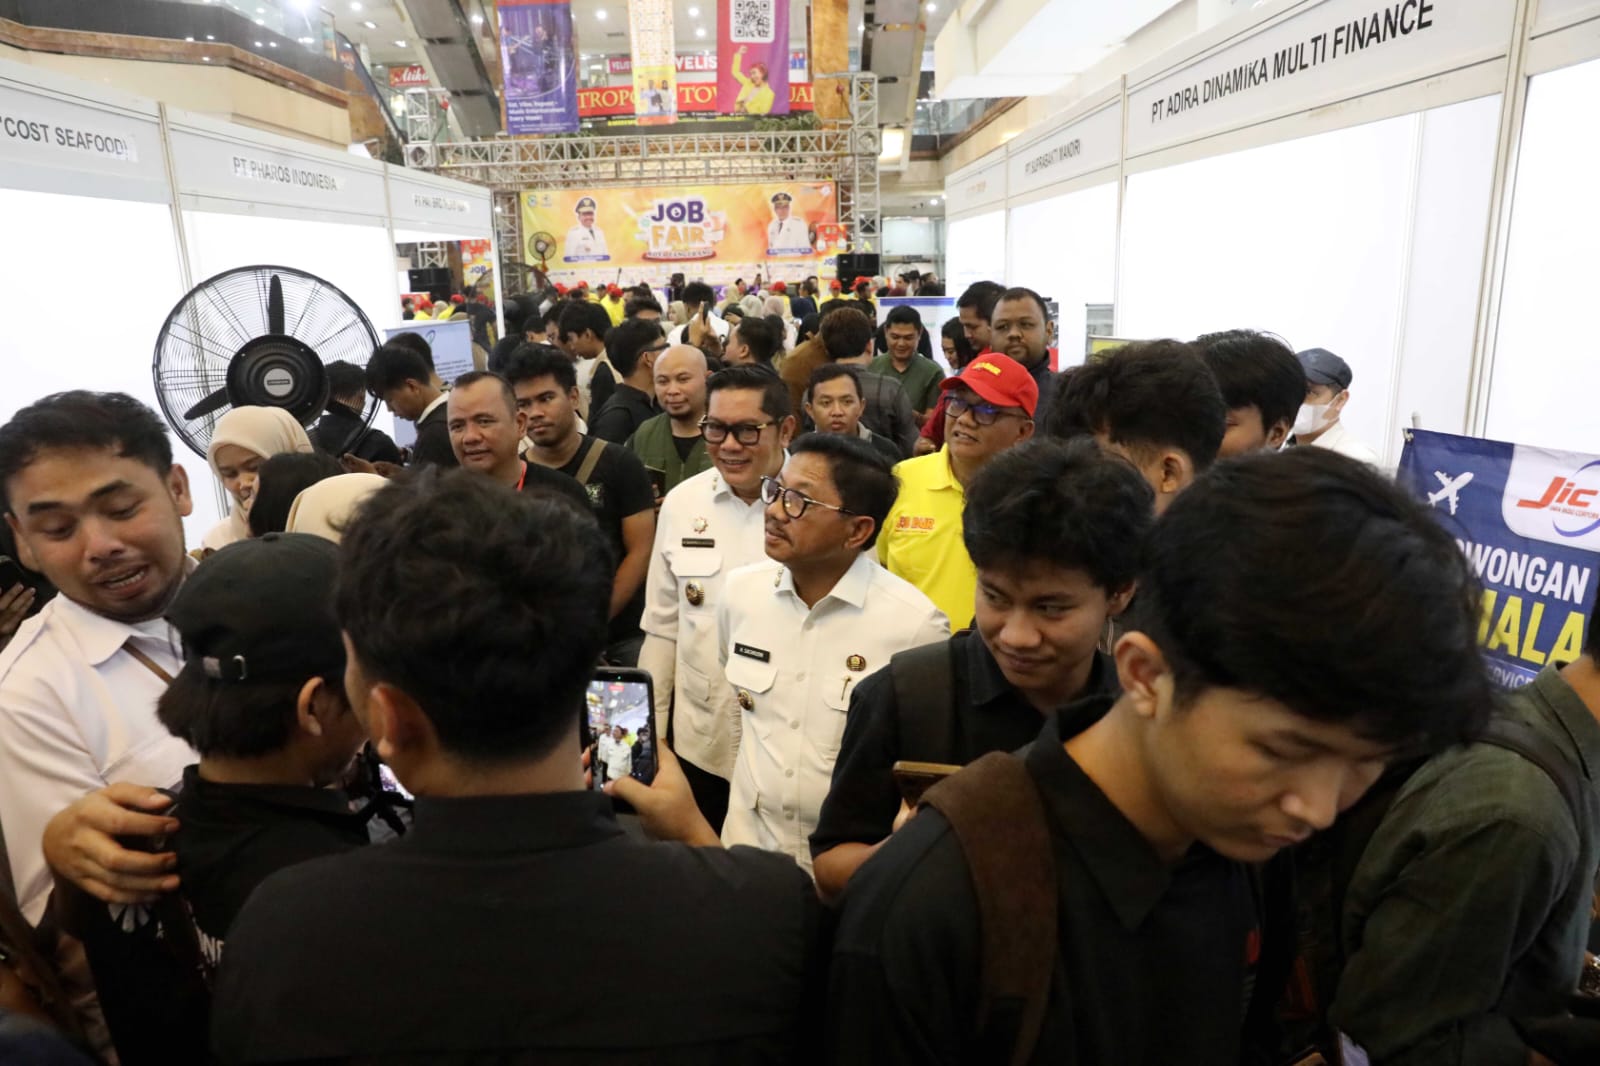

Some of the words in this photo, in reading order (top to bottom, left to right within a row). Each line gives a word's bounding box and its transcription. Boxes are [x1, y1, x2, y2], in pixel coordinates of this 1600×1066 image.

[1151, 98, 1165, 123] PT
[1166, 84, 1200, 117] ADIRA
[1203, 57, 1268, 104] DINAMIKA
[1273, 33, 1327, 80] MULTI
[1332, 0, 1434, 59] FINANCE
[680, 86, 717, 104] TO
[233, 156, 247, 176] PT
[250, 161, 291, 183] PHAROS
[291, 168, 338, 191] INDONESIA
[651, 200, 704, 223] JOB
[651, 225, 705, 248] FAIR
